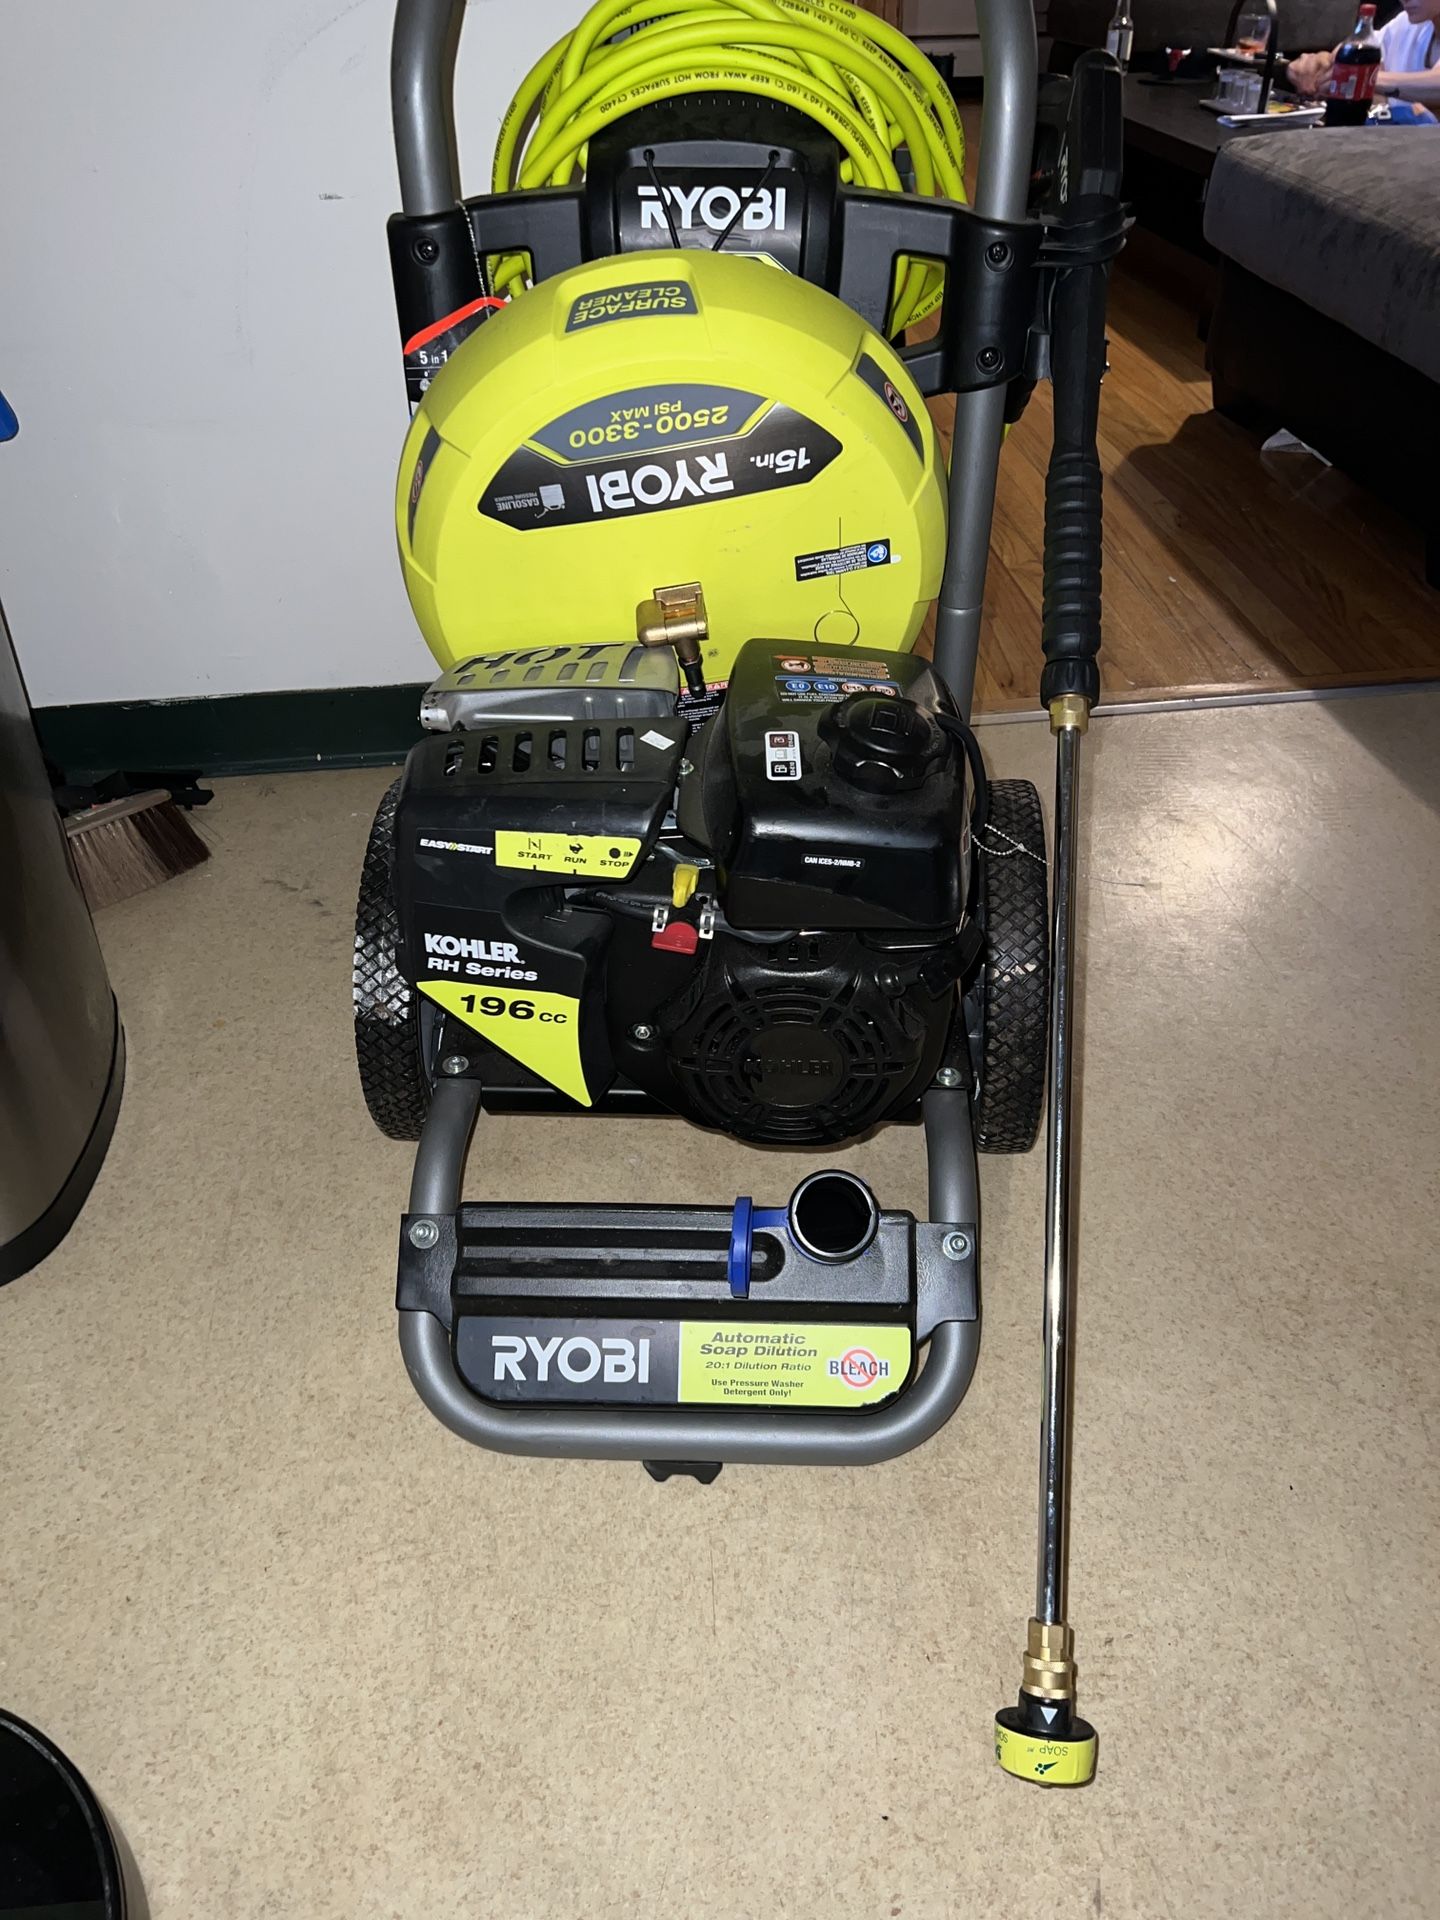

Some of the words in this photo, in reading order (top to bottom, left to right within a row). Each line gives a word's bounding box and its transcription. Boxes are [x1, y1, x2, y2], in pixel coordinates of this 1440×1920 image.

[674, 74, 692, 84] HOT
[695, 70, 720, 80] FROM
[723, 71, 748, 80] AWAY
[750, 72, 770, 84] KEEP
[862, 40, 878, 54] KEEP
[878, 55, 896, 72] AWAY
[896, 70, 912, 91] FROM
[912, 90, 924, 106] HOT
[631, 77, 671, 97] SURFACES
[600, 93, 628, 114] CY4420
[860, 96, 873, 114] KEEP
[638, 186, 786, 230] RYOBI
[578, 286, 681, 310] CLEANER
[572, 297, 688, 324] SURFACE
[420, 350, 428, 364] 5
[431, 355, 440, 364] in
[441, 350, 448, 363] 1
[610, 406, 650, 423] MAX
[654, 400, 682, 416] PSI
[569, 406, 729, 448] 2500-3300
[586, 452, 735, 513] RYOBI
[496, 498, 540, 512] GASOLINE
[454, 642, 626, 674] HOT
[518, 850, 553, 861] START
[564, 856, 587, 864] RUN
[600, 860, 630, 868] STOP
[804, 856, 818, 864] CAN
[427, 957, 460, 972] RH
[466, 962, 538, 981] Series
[712, 1332, 806, 1344] Automatic
[700, 1344, 748, 1358] Soap
[754, 1346, 818, 1357] Dilution
[492, 1336, 650, 1384] RYOBI
[705, 1361, 730, 1369] 20:1
[734, 1362, 777, 1370] Dilution
[781, 1363, 812, 1371] Ratio
[830, 1361, 888, 1376] BLEACH
[730, 1379, 769, 1387] Pressure
[771, 1380, 804, 1388] Washer
[723, 1388, 767, 1397] Detergent
[769, 1389, 792, 1398] Only!
[1040, 1746, 1069, 1757] SOAP
